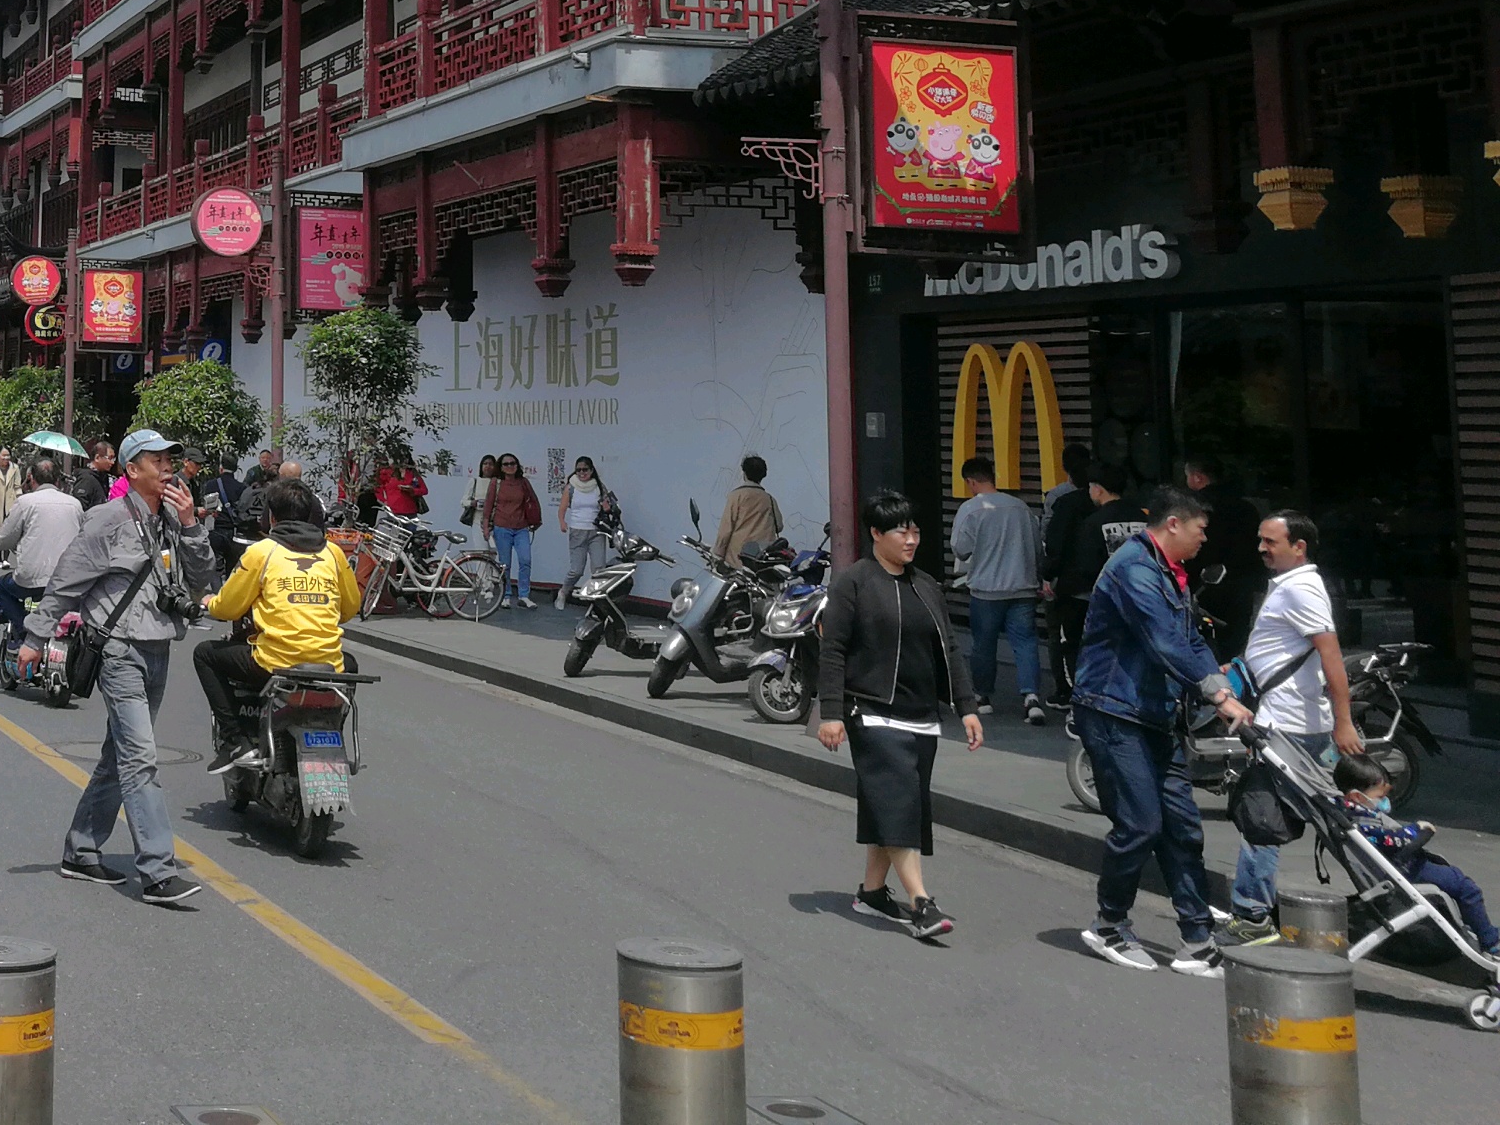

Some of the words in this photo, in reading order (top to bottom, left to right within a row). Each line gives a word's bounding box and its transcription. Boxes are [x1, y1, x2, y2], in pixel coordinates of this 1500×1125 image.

[445, 302, 620, 392] 上海好味道
[487, 398, 556, 426] SHANGHAI
[559, 397, 620, 425] FLAVOR
[276, 576, 338, 594] 美团外卖
[293, 594, 326, 604] 美团专送
